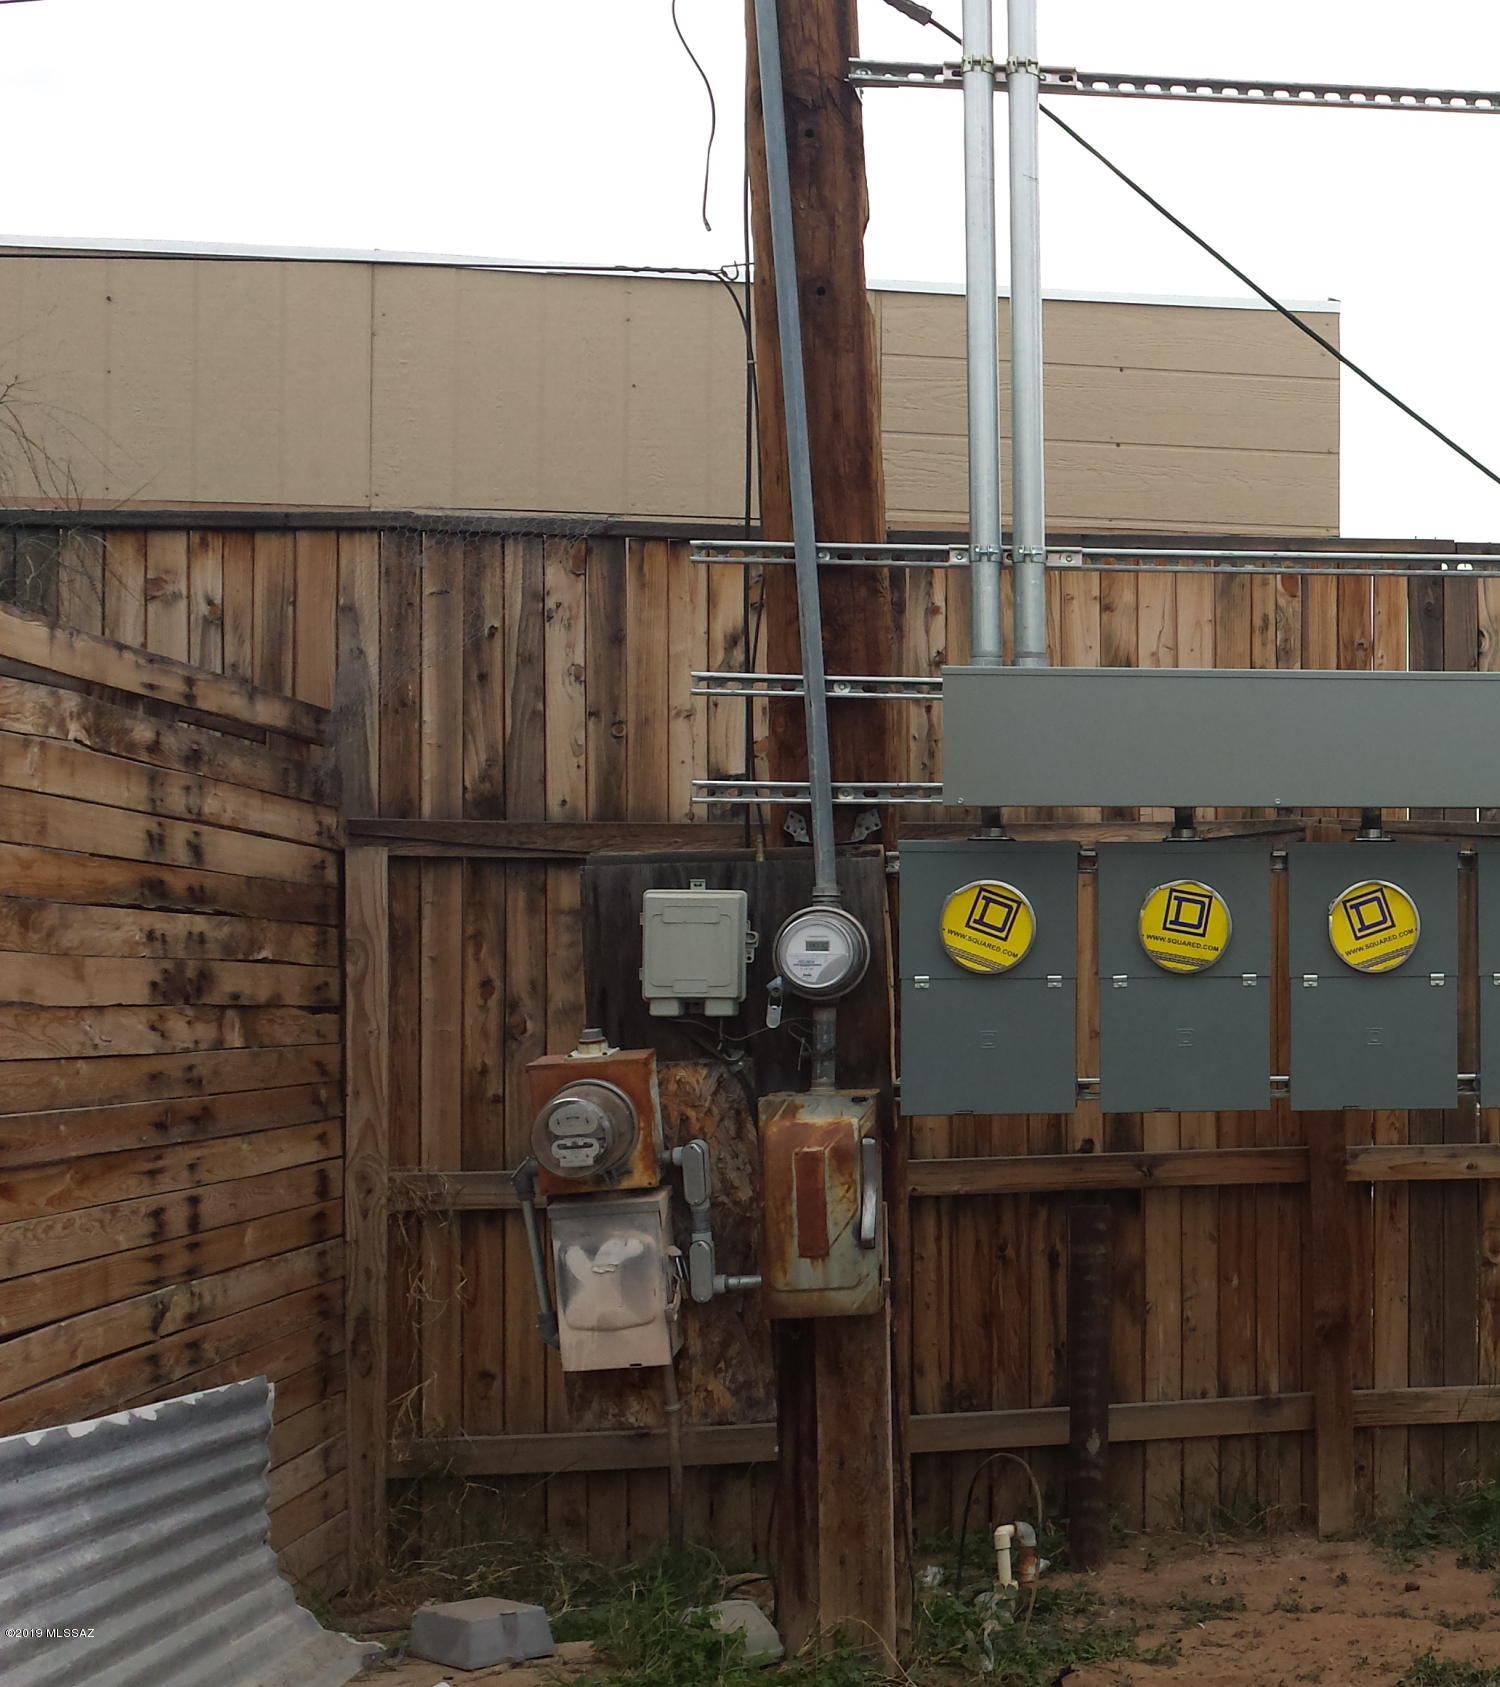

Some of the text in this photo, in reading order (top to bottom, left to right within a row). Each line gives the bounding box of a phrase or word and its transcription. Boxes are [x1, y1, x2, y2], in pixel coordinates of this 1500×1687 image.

[947, 928, 1019, 958] WWW.SQUARED.COM
[1146, 933, 1219, 952] WWW.SQUARED.COM
[1344, 929, 1414, 957] WWW.SQUARED.COM
